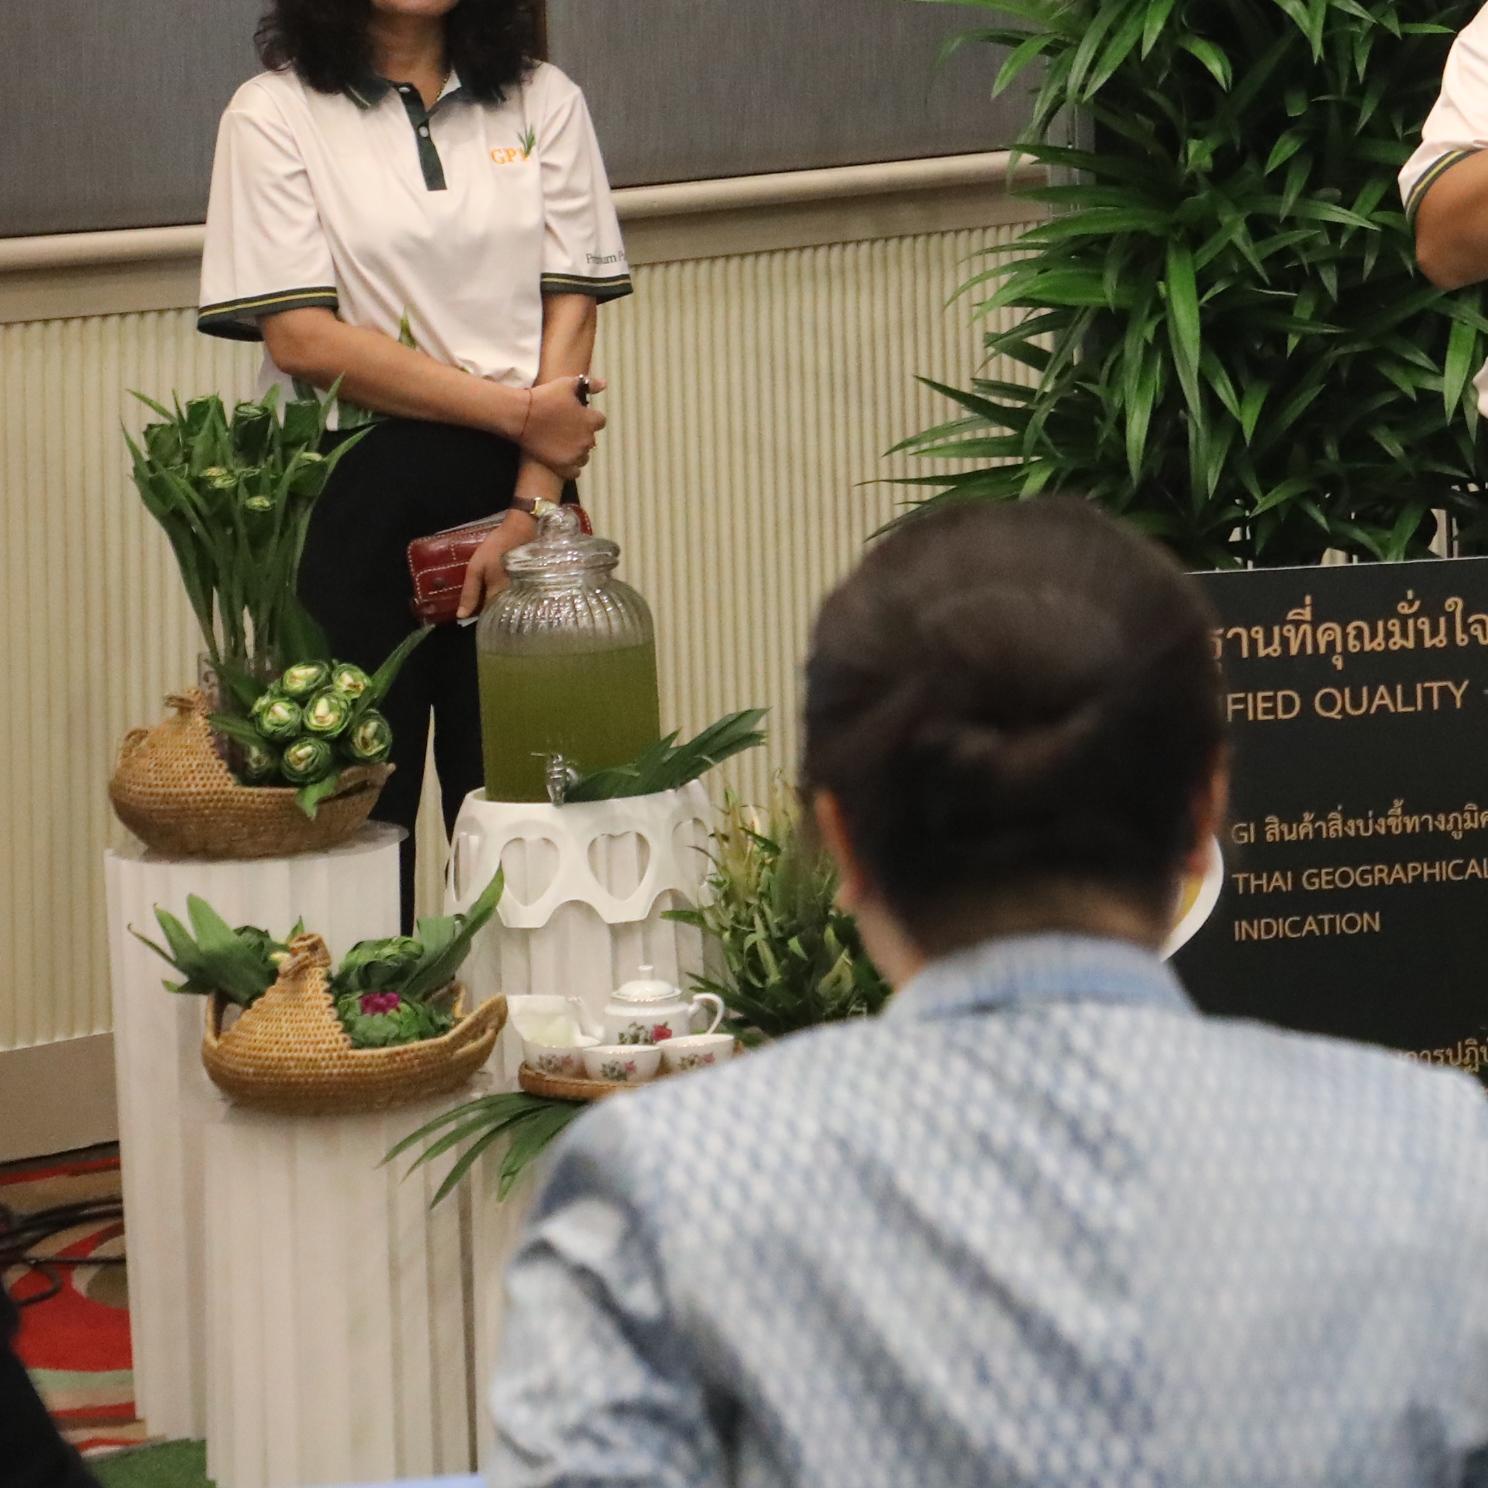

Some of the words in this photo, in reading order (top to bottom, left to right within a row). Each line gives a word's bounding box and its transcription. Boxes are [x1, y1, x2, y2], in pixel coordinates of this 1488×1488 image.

[491, 147, 530, 165] GP1
[1314, 679, 1470, 720] QUALITY
[1230, 822, 1255, 845] GI
[1231, 870, 1292, 895] THAI
[1234, 911, 1381, 942] INDICATION
